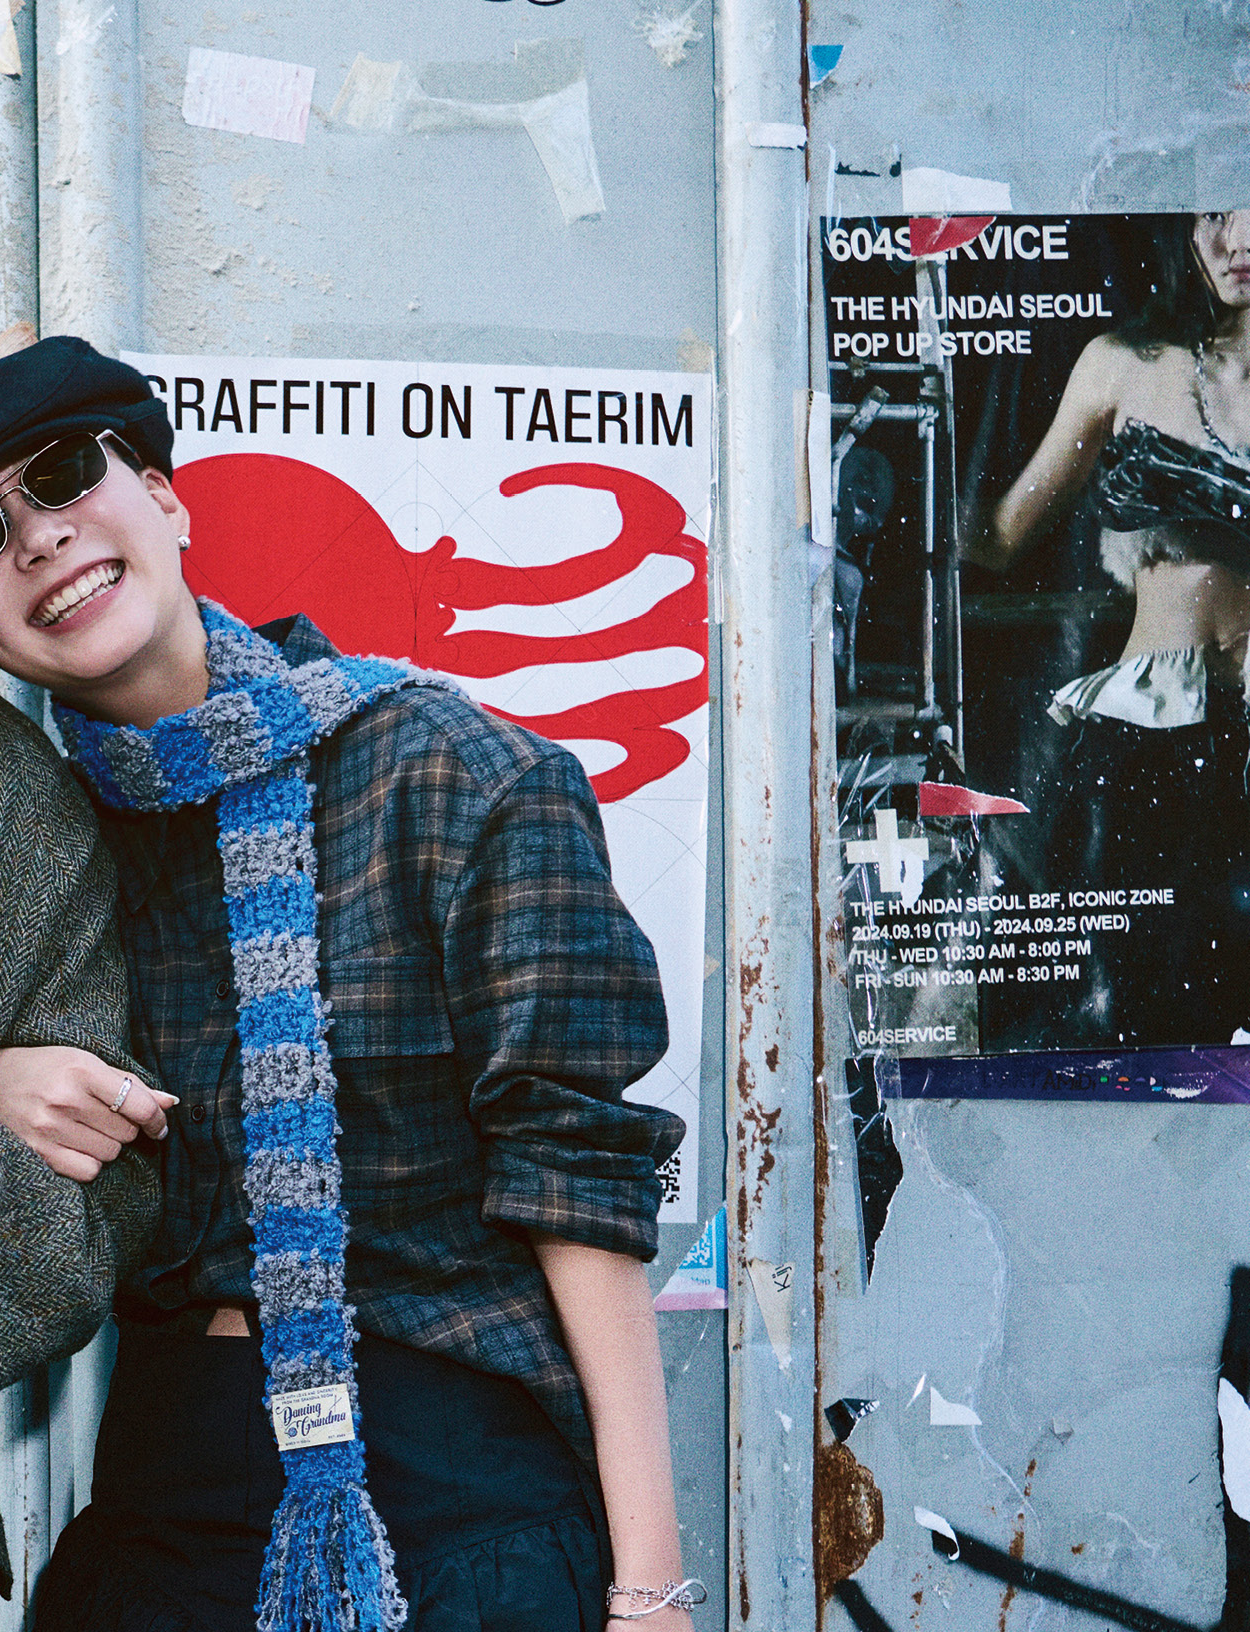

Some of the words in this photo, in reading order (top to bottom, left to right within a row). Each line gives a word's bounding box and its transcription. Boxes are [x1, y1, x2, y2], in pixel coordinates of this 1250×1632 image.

[830, 296, 886, 321] THE
[890, 294, 1014, 321] HYUNDAI
[1019, 293, 1113, 319] SEOUL
[833, 332, 890, 357] POP
[895, 332, 933, 357] UP
[938, 330, 1032, 356] STORE
[401, 382, 473, 440] ON
[494, 385, 694, 448] TAERIM
[849, 900, 885, 917] THE
[888, 897, 963, 916] HYUNDAI
[965, 894, 1026, 913] SEOUL
[1029, 892, 1066, 911] B2F,
[1068, 889, 1127, 908] ICONIC
[1129, 888, 1175, 905] ZONE
[851, 922, 932, 942] 2024.09.19
[934, 920, 981, 942] (THU)
[993, 915, 1077, 935] 2024.09.25
[1079, 914, 1131, 935] (WED)
[855, 949, 887, 965] THU
[899, 947, 939, 963] WED
[942, 944, 985, 962] 10:30
[988, 943, 1016, 959] AM
[1028, 941, 1061, 957] 8:00
[1065, 939, 1092, 956] PM
[855, 973, 882, 989] FRI
[893, 971, 928, 988] SUN
[932, 969, 974, 986] 10:30
[977, 967, 1004, 984] AM
[1017, 965, 1050, 982] 8:30
[1053, 964, 1080, 981] PM
[857, 1025, 957, 1046] 604SERVICE
[297, 1410, 347, 1437] Grandma
